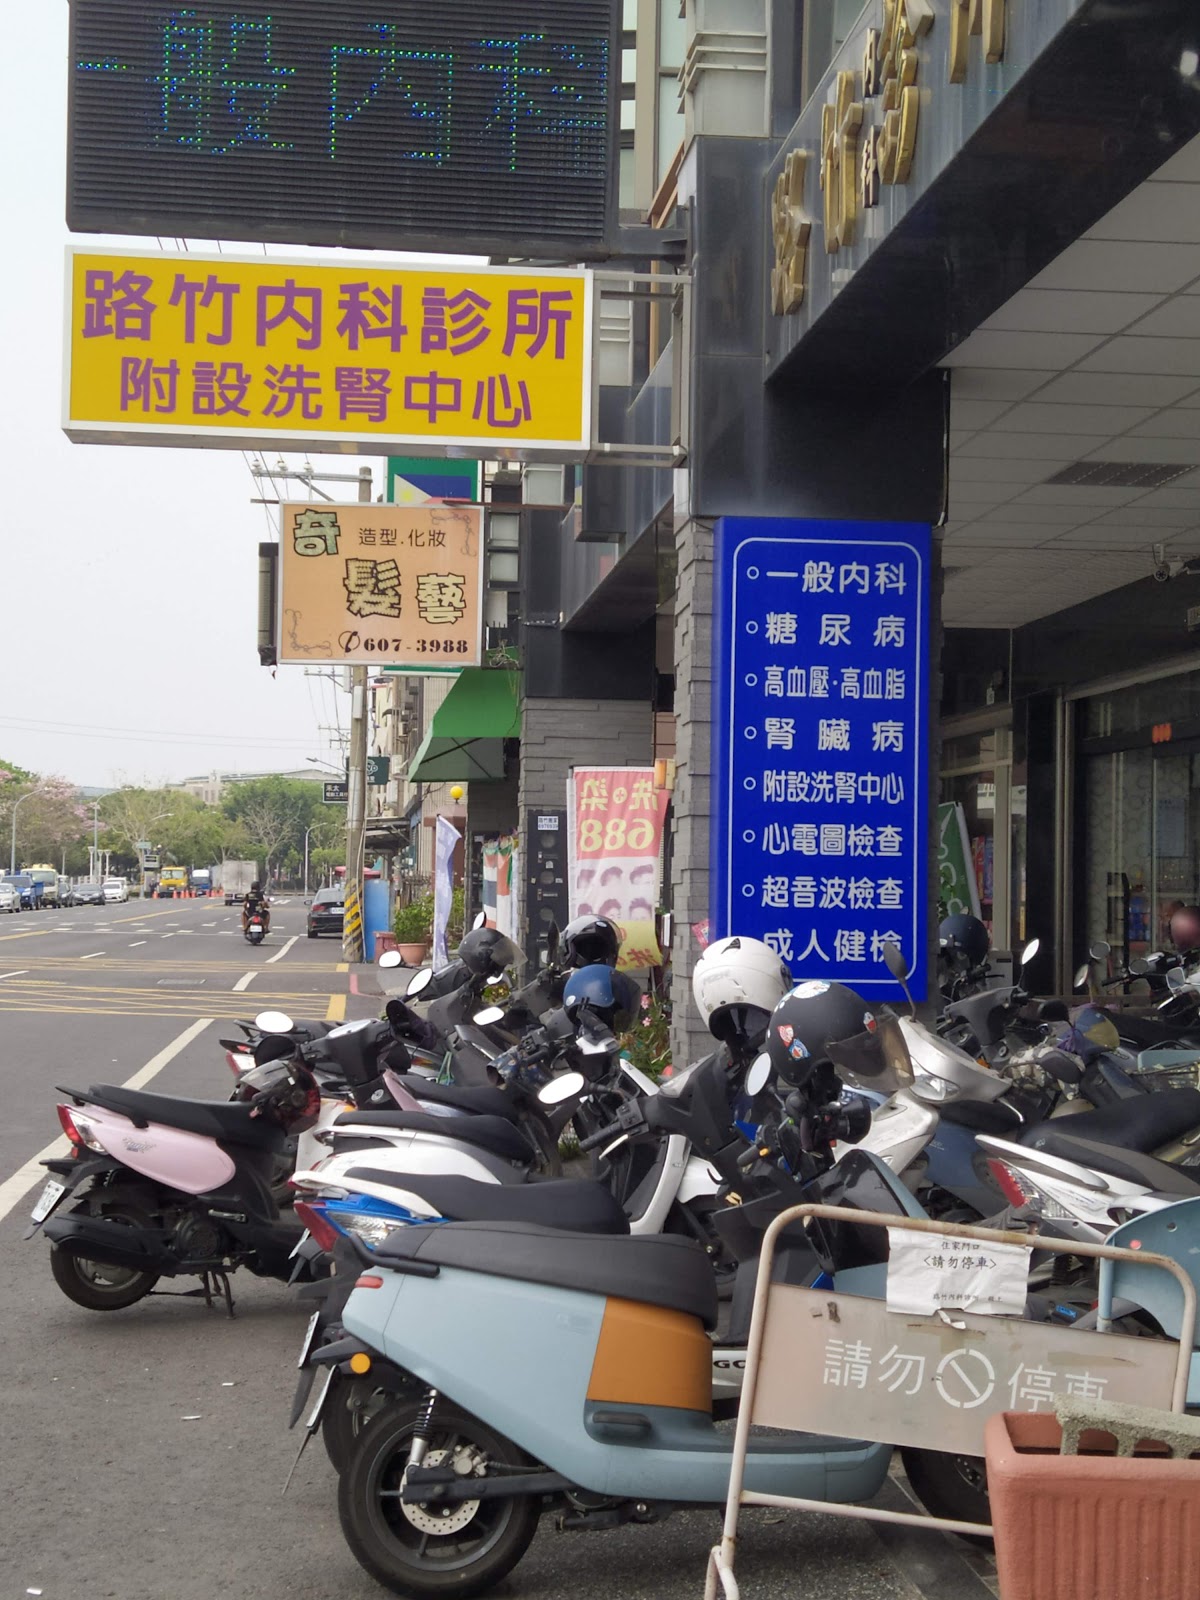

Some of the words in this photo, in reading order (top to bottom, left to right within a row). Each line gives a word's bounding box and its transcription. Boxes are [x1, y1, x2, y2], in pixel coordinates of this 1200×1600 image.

[81, 269, 573, 360] 路竹內科診所
[120, 356, 532, 428] 附設洗腎中心
[766, 560, 907, 595] 一般內科
[363, 638, 469, 654] 607-3988
[764, 611, 906, 647] 糖尿病
[764, 717, 905, 752] 腎臟病
[763, 769, 905, 804] 附設洗腎中心
[762, 822, 903, 857] 心電圖檢查
[761, 875, 904, 910] 超音波檢查
